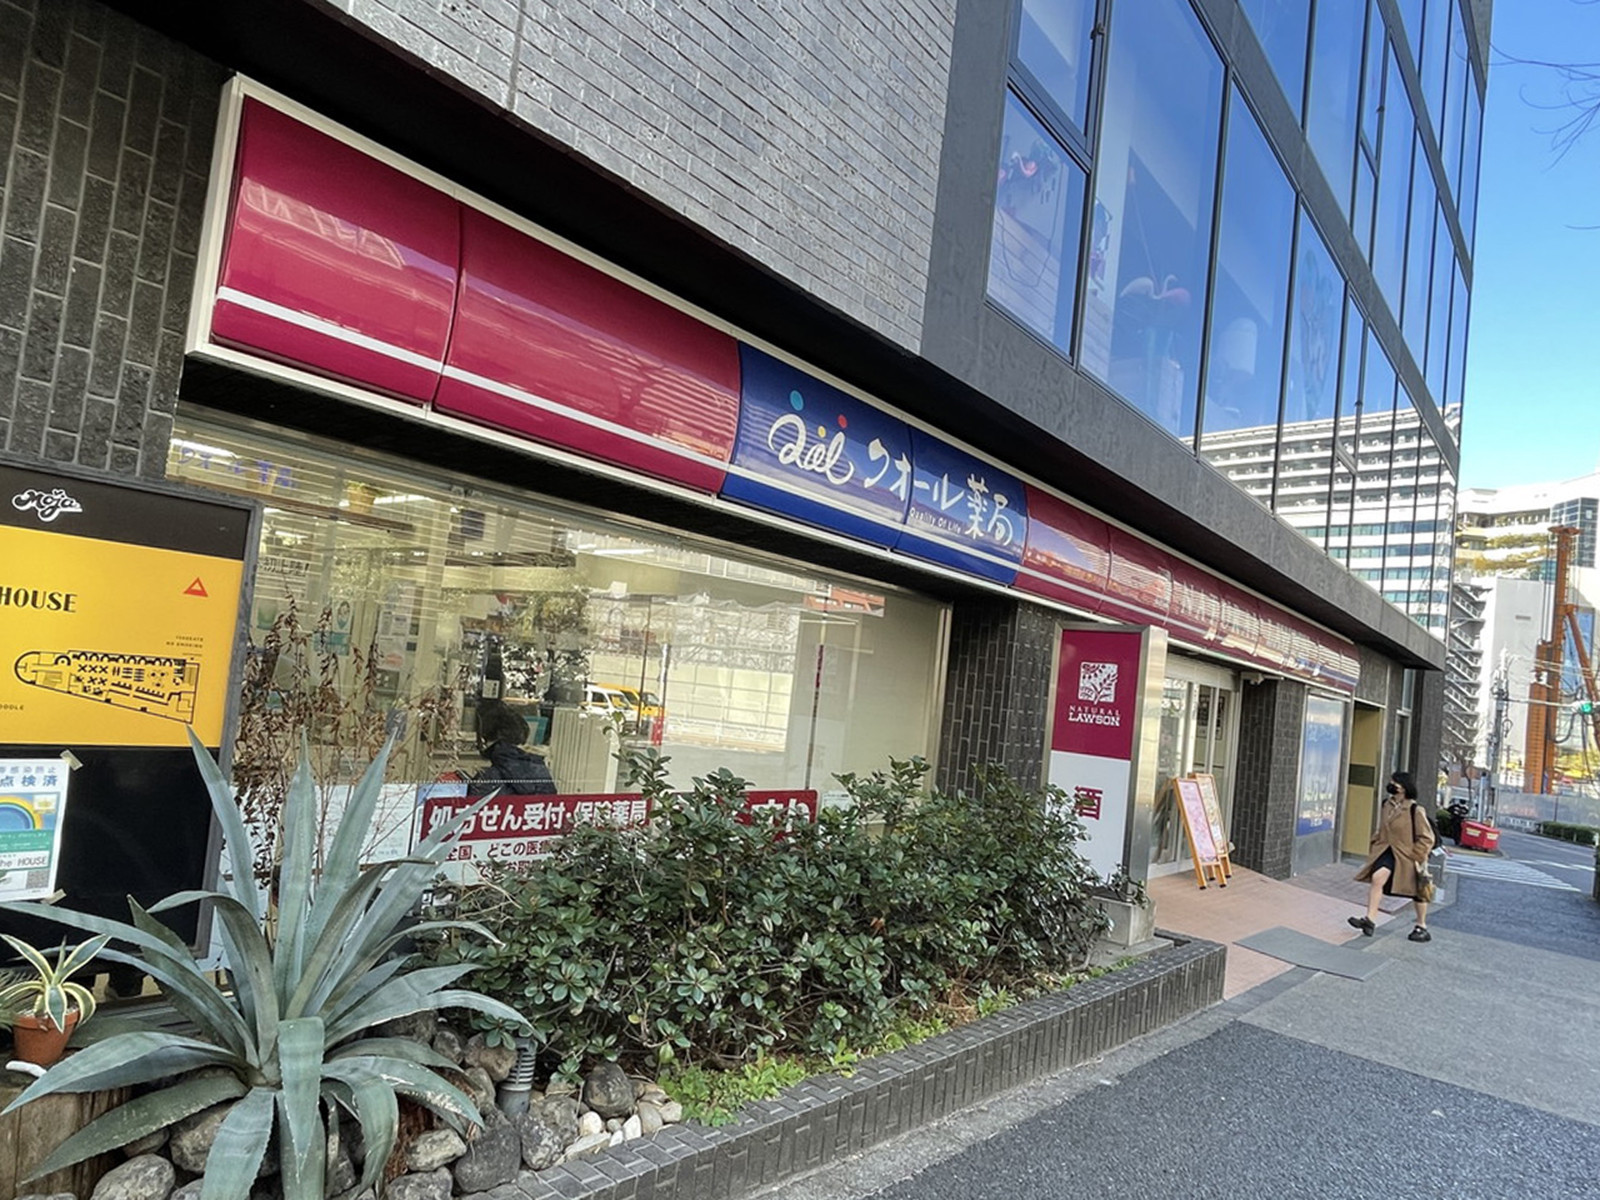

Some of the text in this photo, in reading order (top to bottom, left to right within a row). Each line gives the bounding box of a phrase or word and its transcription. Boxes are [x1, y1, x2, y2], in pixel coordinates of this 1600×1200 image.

[863, 437, 1013, 547] クオール薬局
[909, 507, 936, 526] Quality
[0, 586, 78, 613] HOUSE
[1067, 712, 1121, 728] LAWSON
[1069, 704, 1120, 717] NATURAL
